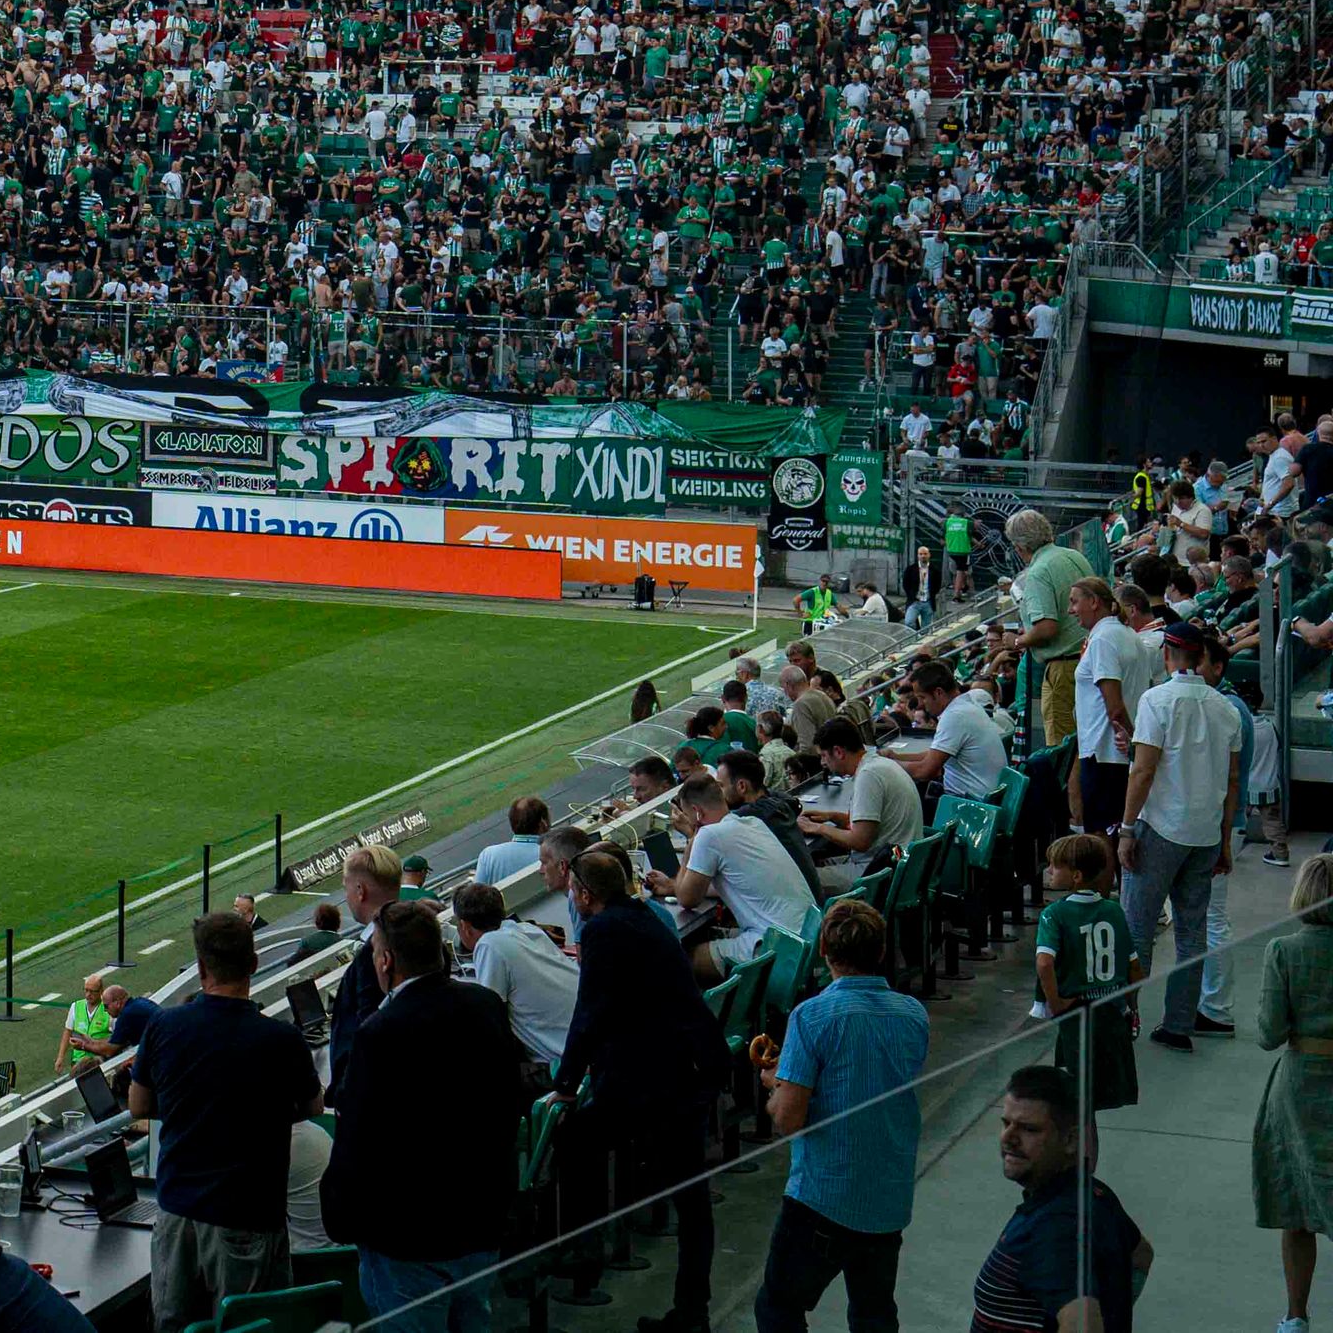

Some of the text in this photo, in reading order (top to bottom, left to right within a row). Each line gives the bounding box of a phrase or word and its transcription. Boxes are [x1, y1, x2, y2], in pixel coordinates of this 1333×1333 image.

[155, 431, 263, 455] GLADIATORI
[671, 448, 765, 469] SEKTION
[144, 471, 270, 490] SEMPER FIDELIS
[671, 477, 765, 498] MEIDLING
[770, 525, 826, 539] General
[525, 534, 742, 568] WIEN ENERGIE
[1079, 921, 1115, 982] 18
